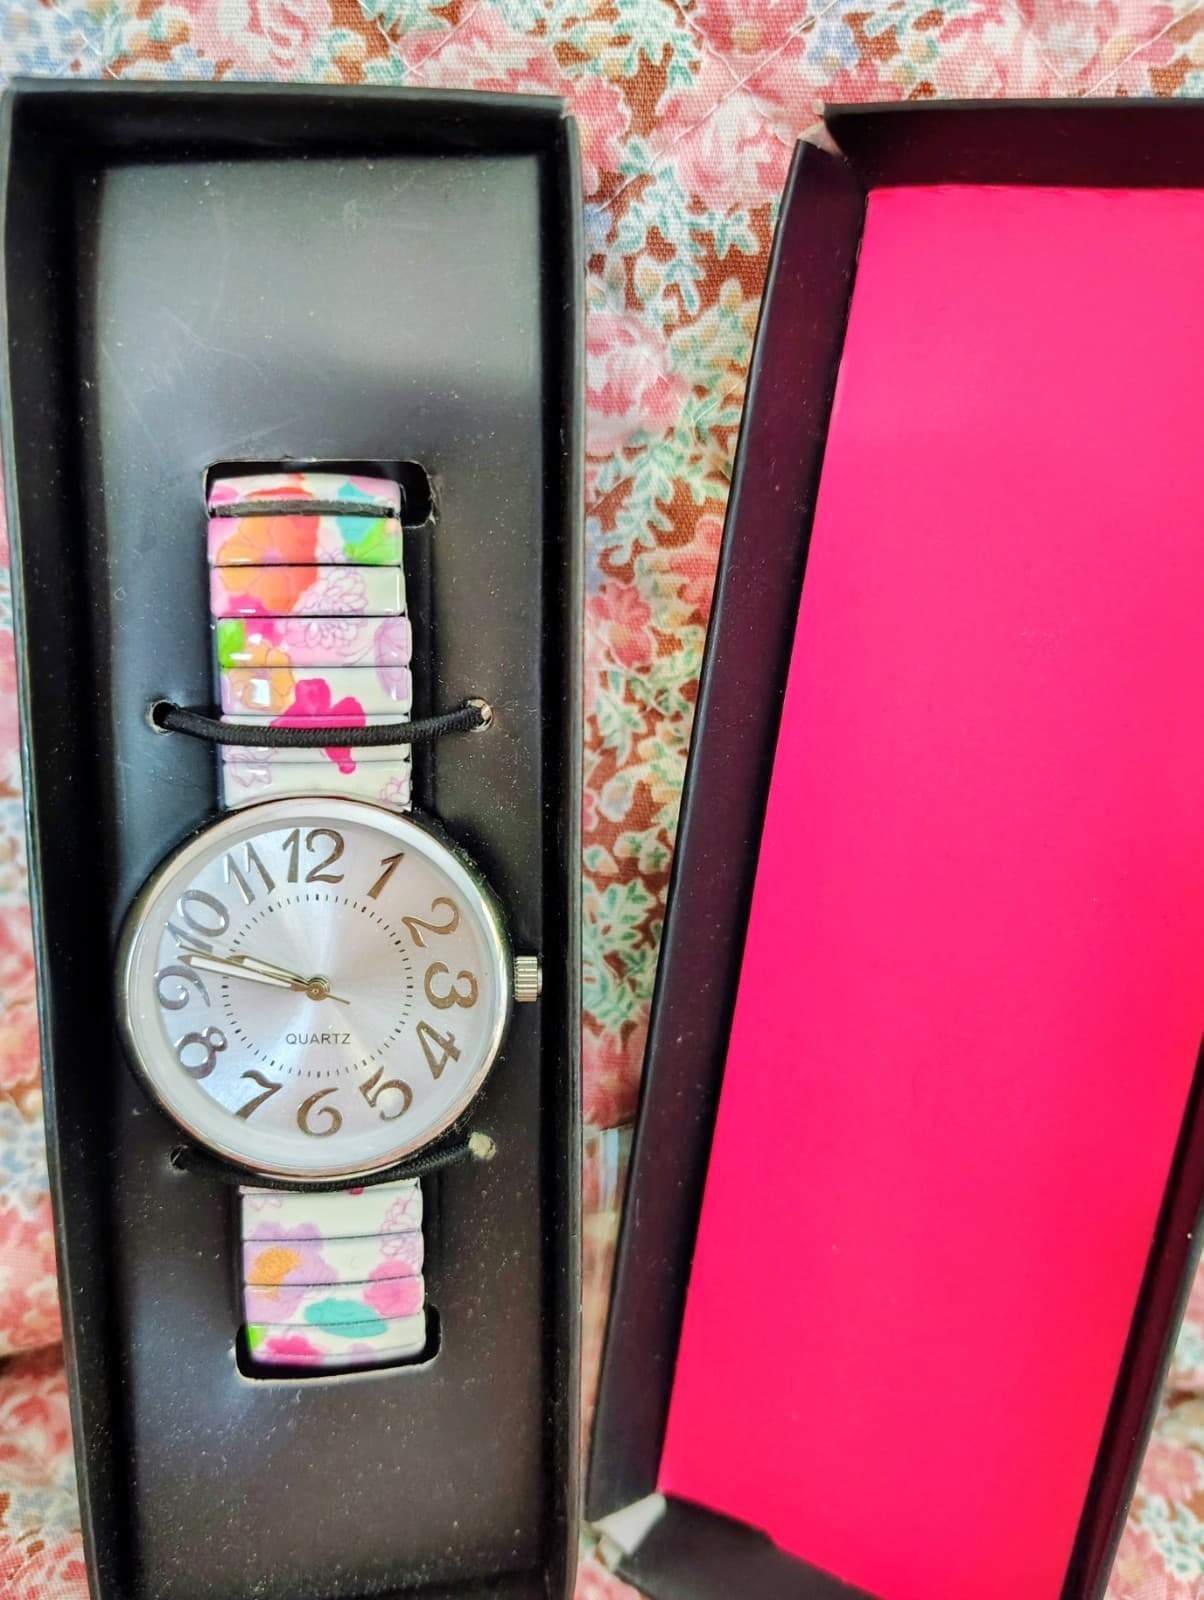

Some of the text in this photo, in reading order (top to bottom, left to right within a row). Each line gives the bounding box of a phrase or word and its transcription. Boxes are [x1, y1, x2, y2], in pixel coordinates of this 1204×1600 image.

[223, 842, 276, 905] 11
[282, 828, 345, 884] 12
[367, 852, 405, 900] 1
[165, 889, 231, 953] 10
[401, 896, 460, 948] 2
[154, 965, 211, 1011] 9
[424, 961, 479, 1009] 3
[174, 1026, 228, 1080] 8
[285, 1032, 351, 1046] QUARTZ
[415, 1020, 462, 1080] 4
[233, 1069, 283, 1121] 7
[296, 1087, 343, 1137] 6
[358, 1066, 414, 1121] 5
